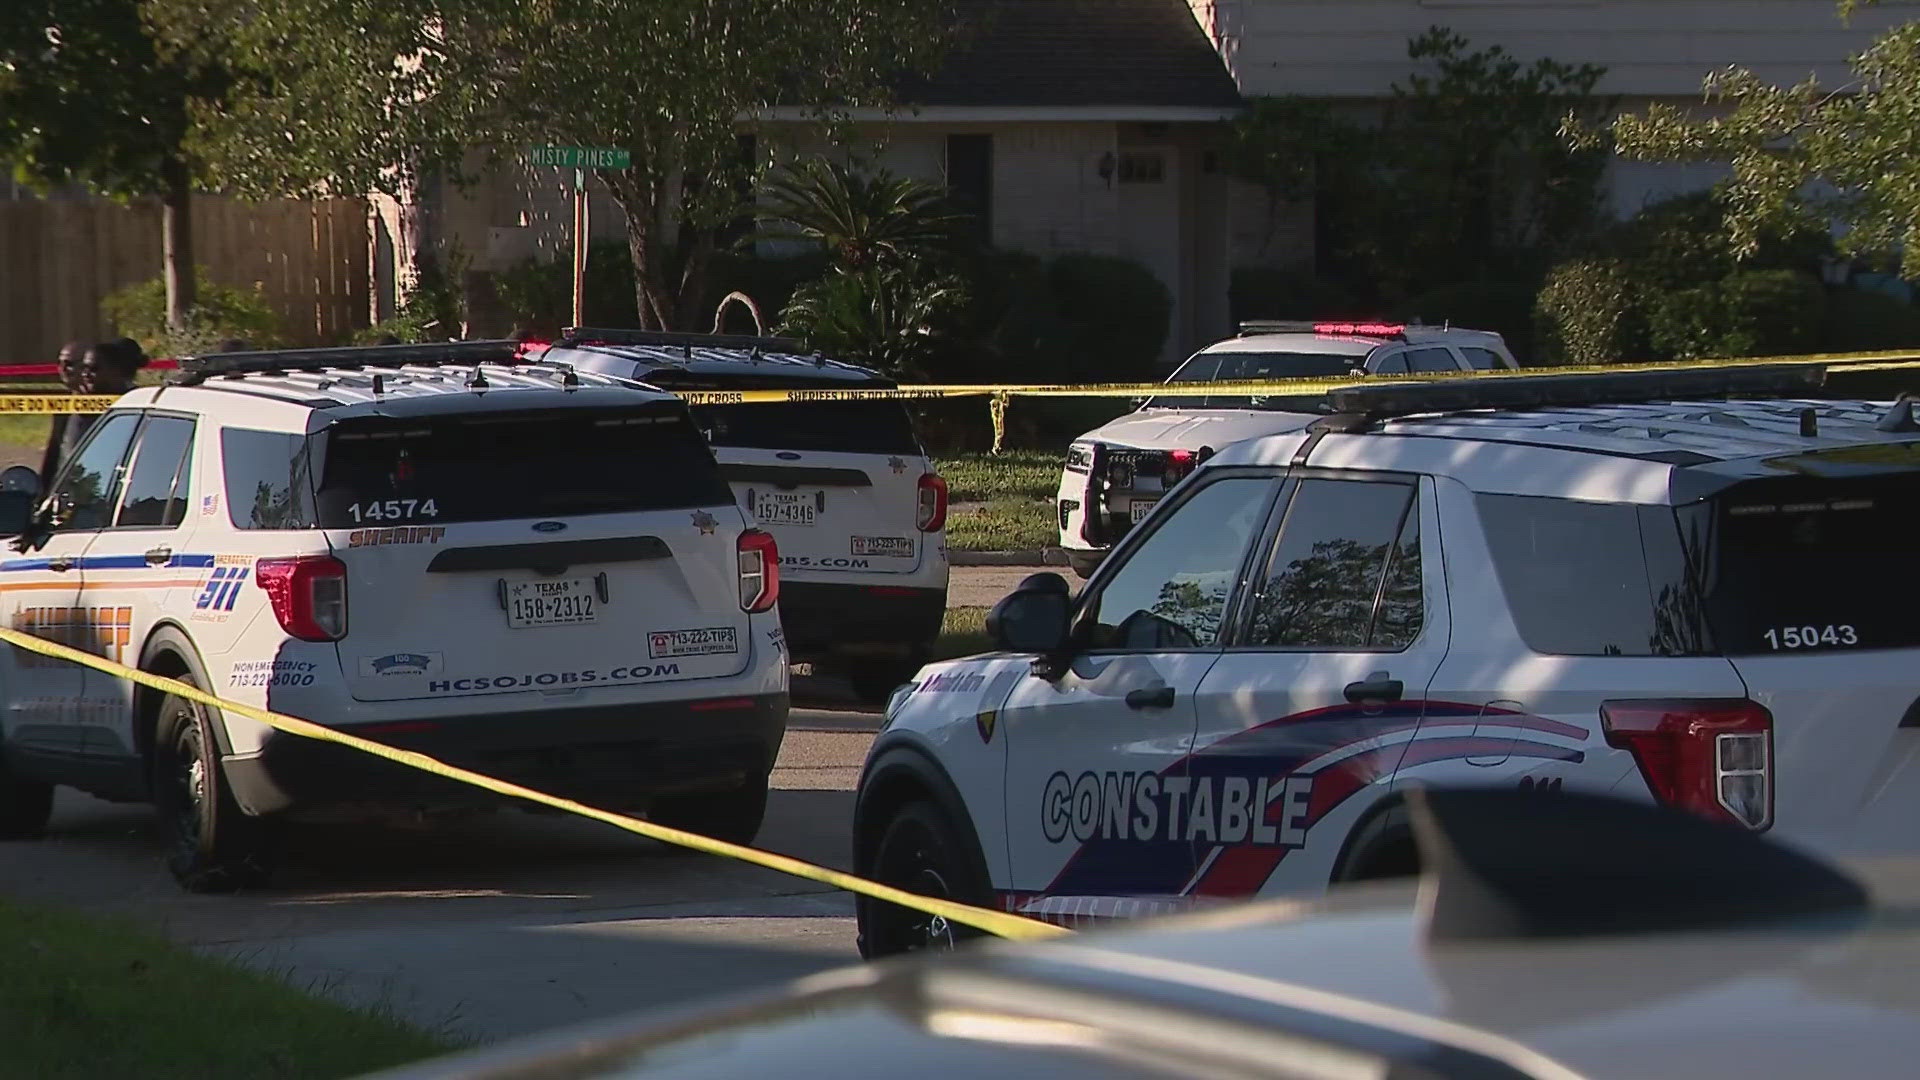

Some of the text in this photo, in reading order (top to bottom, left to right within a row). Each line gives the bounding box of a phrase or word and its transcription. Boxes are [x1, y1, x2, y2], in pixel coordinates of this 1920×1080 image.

[531, 148, 569, 165] MISTY
[577, 150, 614, 166] PINES
[27, 398, 43, 411] DO
[47, 398, 70, 411] NOT
[707, 393, 742, 404] CROSS
[348, 498, 438, 522] 14574
[349, 527, 446, 548] SHERIFF
[196, 567, 250, 611] 911
[535, 582, 569, 592] TEXAS
[671, 629, 734, 645] 713-222-TIPS
[1763, 624, 1858, 650] 15043
[429, 663, 680, 692] HCSOJOBS.COM
[1041, 770, 1314, 849] CONSTABLE
